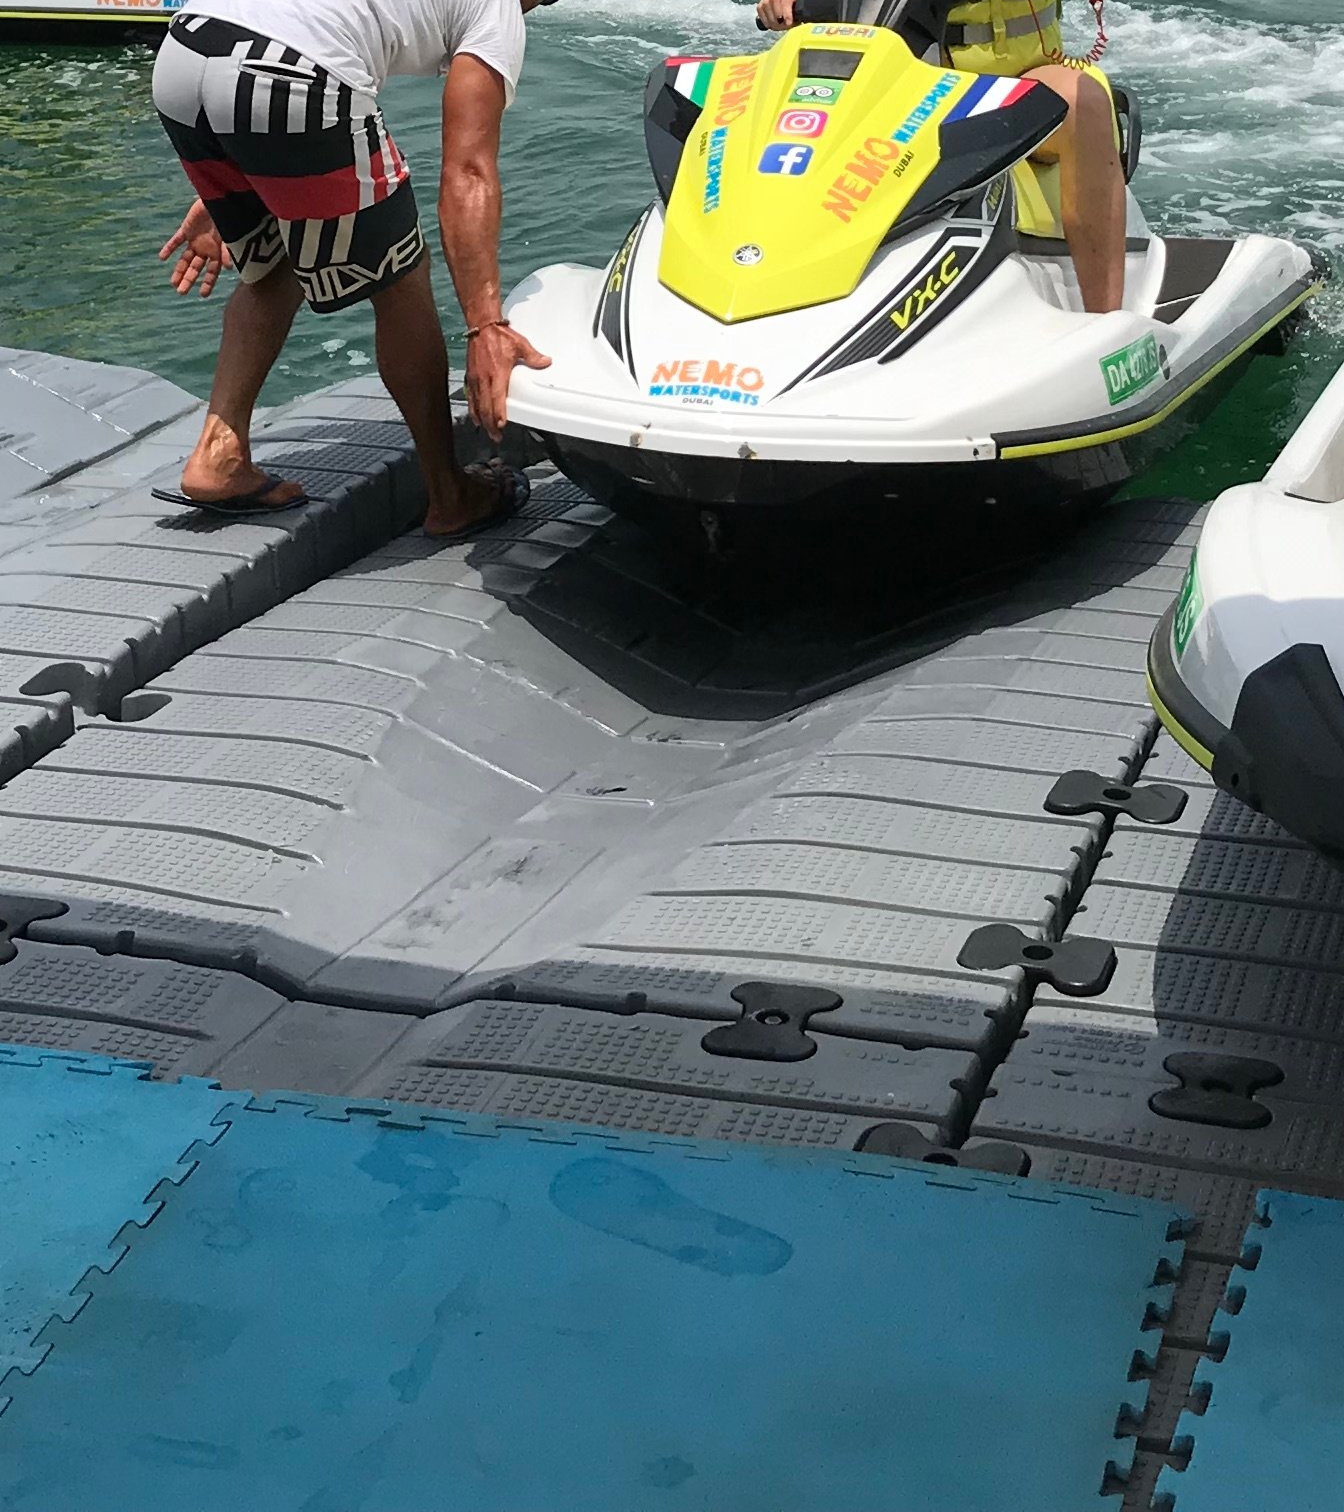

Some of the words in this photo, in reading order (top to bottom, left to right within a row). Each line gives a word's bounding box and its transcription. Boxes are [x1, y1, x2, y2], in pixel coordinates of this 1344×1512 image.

[810, 25, 877, 39] DUBAI
[714, 59, 759, 127] NEMO
[821, 137, 900, 224] NEMO
[890, 71, 962, 145] WATERSPORTS
[892, 150, 915, 179] DUBAI
[890, 250, 959, 330] VX-C
[650, 359, 765, 392] NEMO
[1107, 360, 1131, 393] DA
[648, 385, 760, 406] WATERSPORTS
[682, 396, 714, 406] DUBAI
